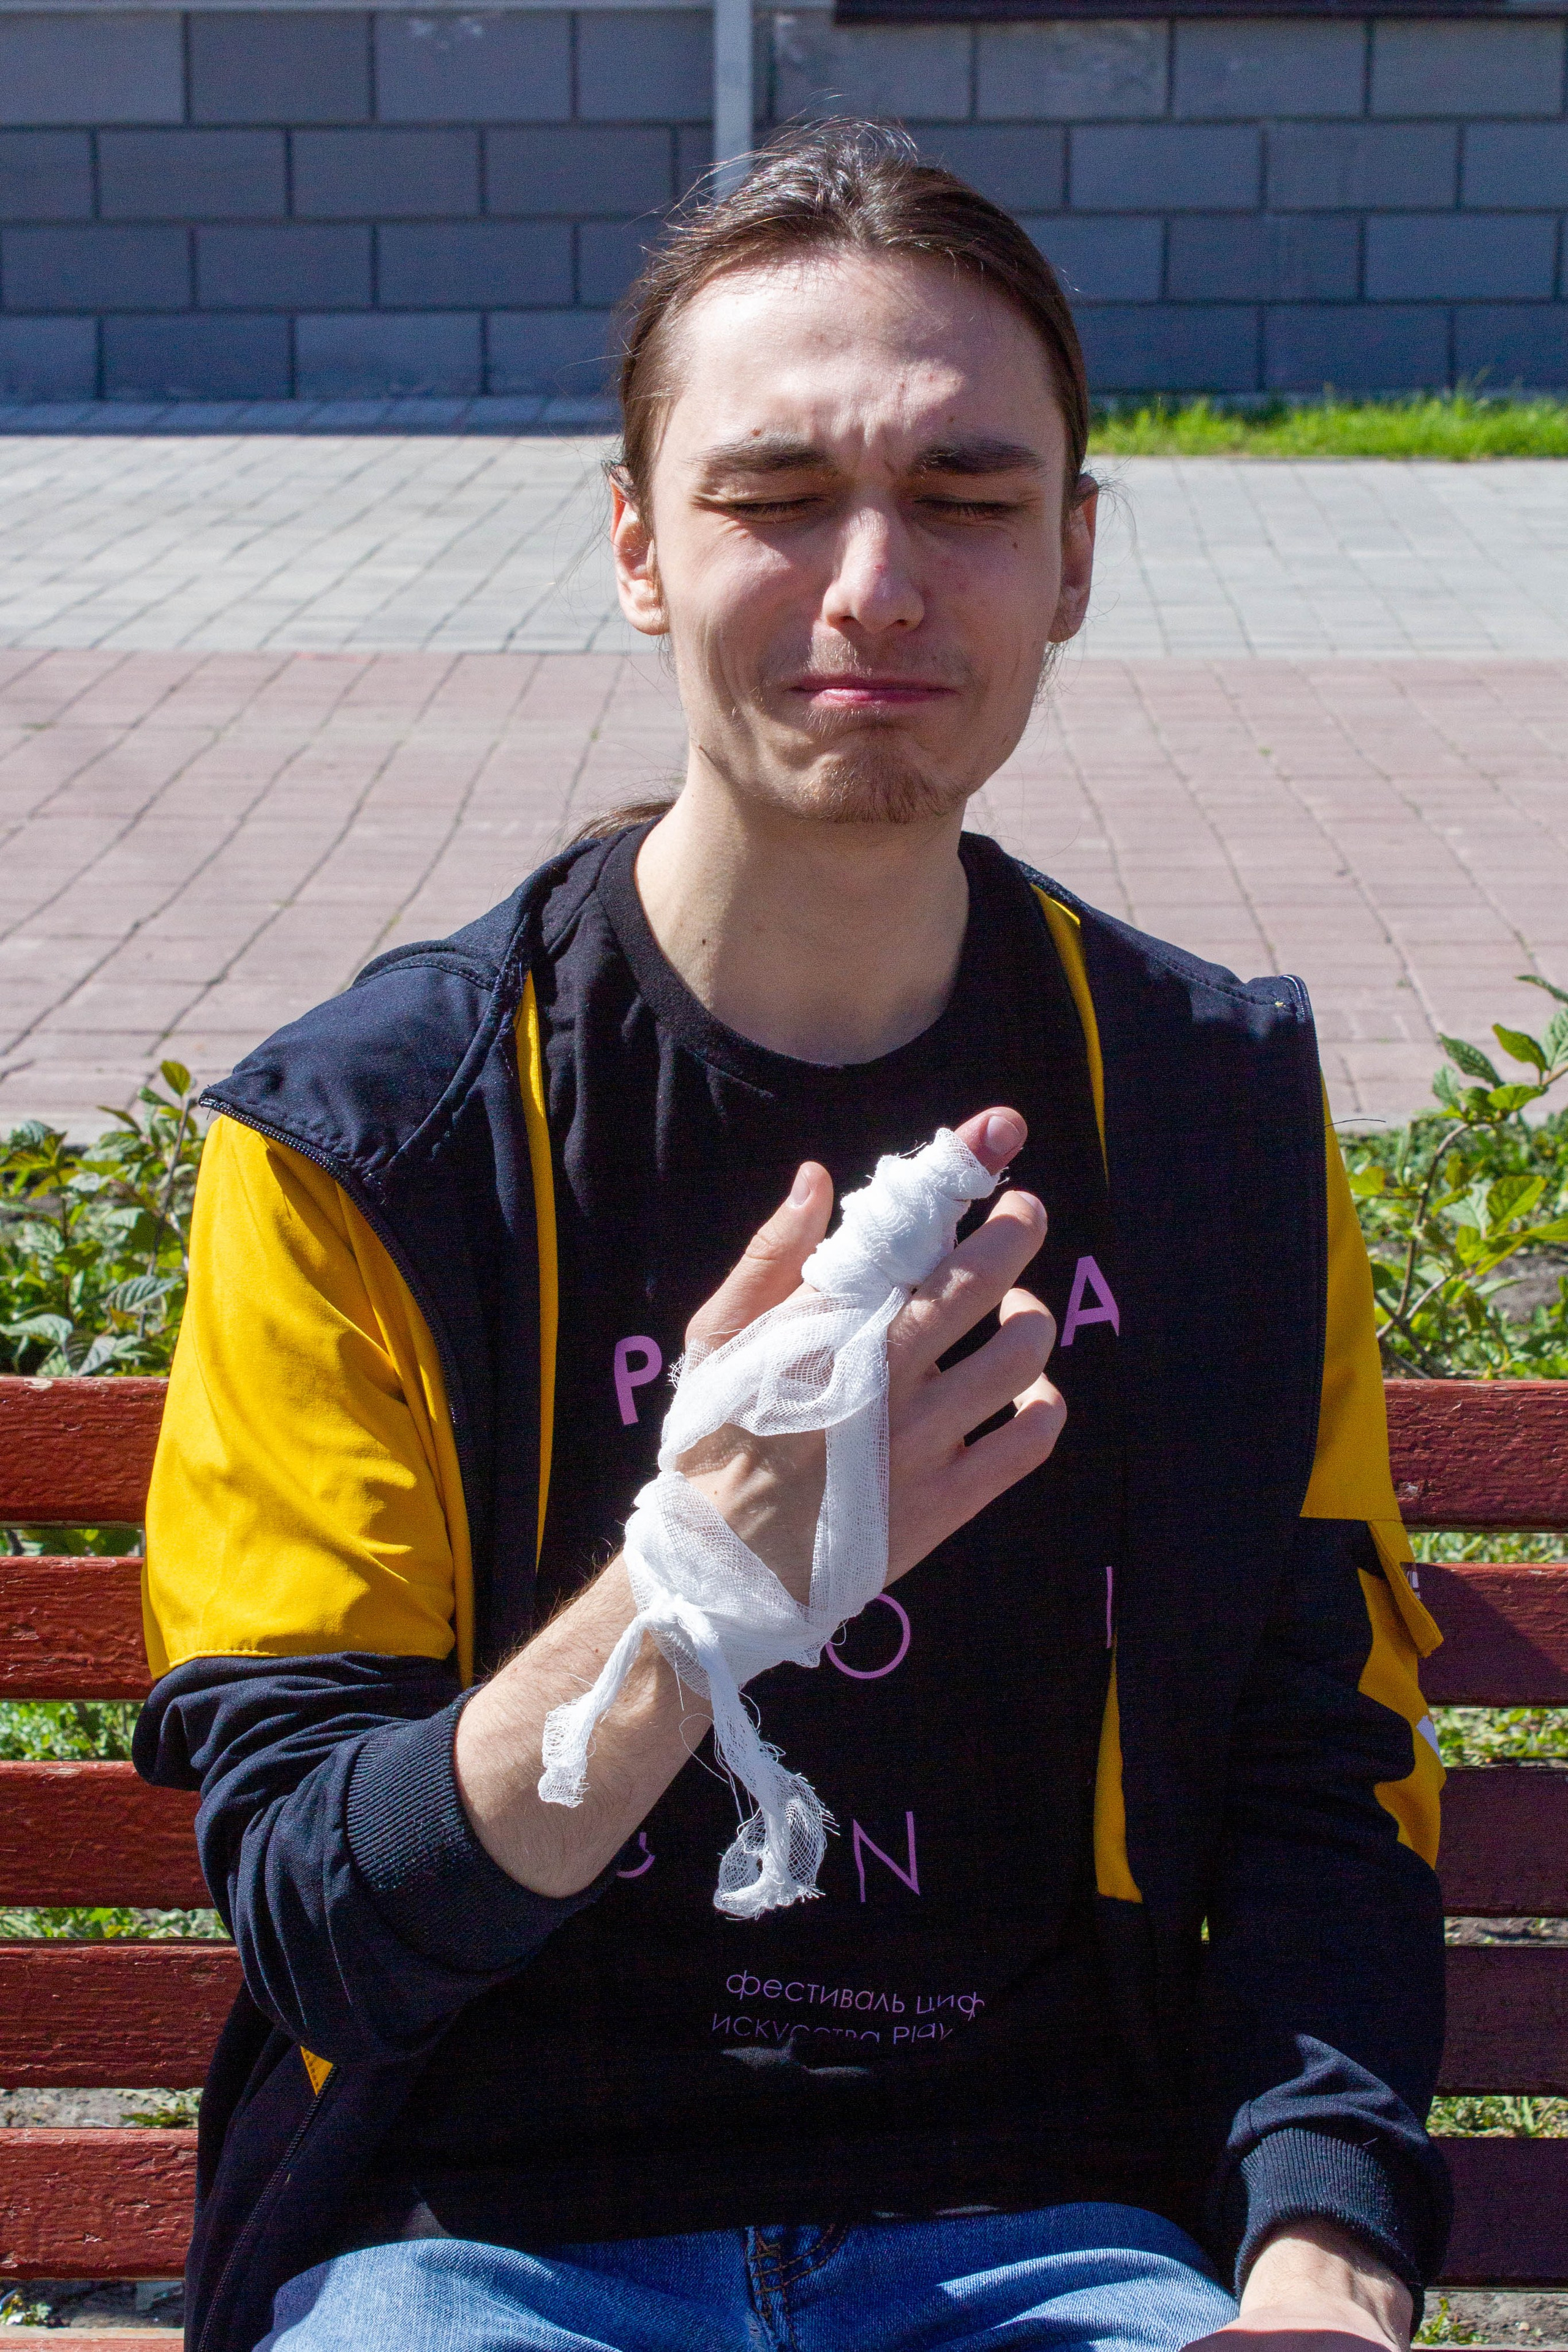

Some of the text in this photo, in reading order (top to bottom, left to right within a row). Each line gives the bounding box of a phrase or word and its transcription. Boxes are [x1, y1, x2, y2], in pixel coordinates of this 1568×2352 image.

[1060, 1255, 1120, 1348] A
[614, 1335, 662, 1425] P
[853, 1811, 921, 1903] N
[726, 1970, 905, 2015] фестиваль
